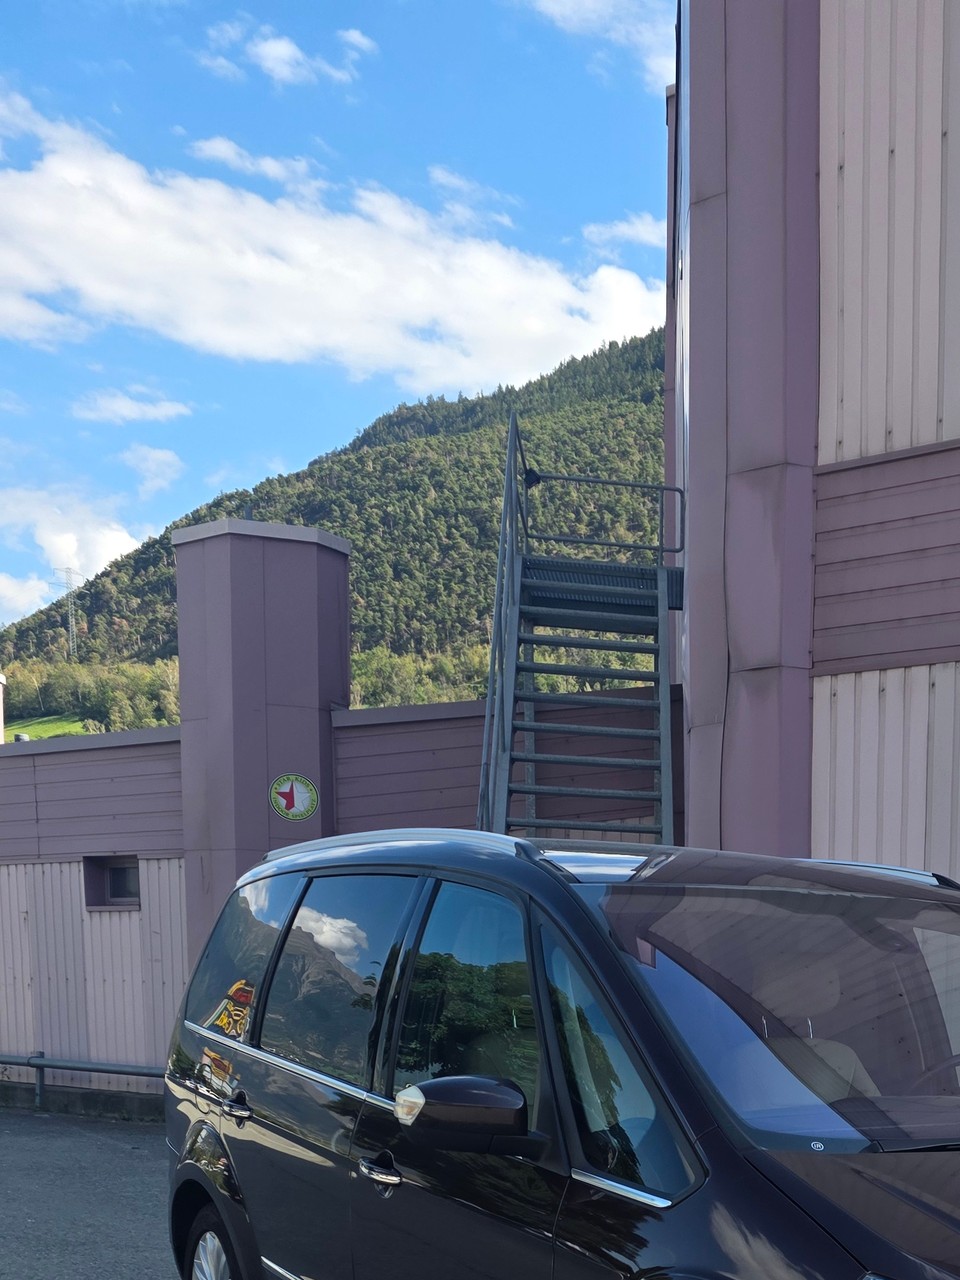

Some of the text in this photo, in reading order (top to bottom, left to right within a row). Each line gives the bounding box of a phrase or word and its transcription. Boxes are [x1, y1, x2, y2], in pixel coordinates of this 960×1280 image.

[276, 776, 310, 788] STAR KIDS
[272, 797, 290, 817] INDOOR
